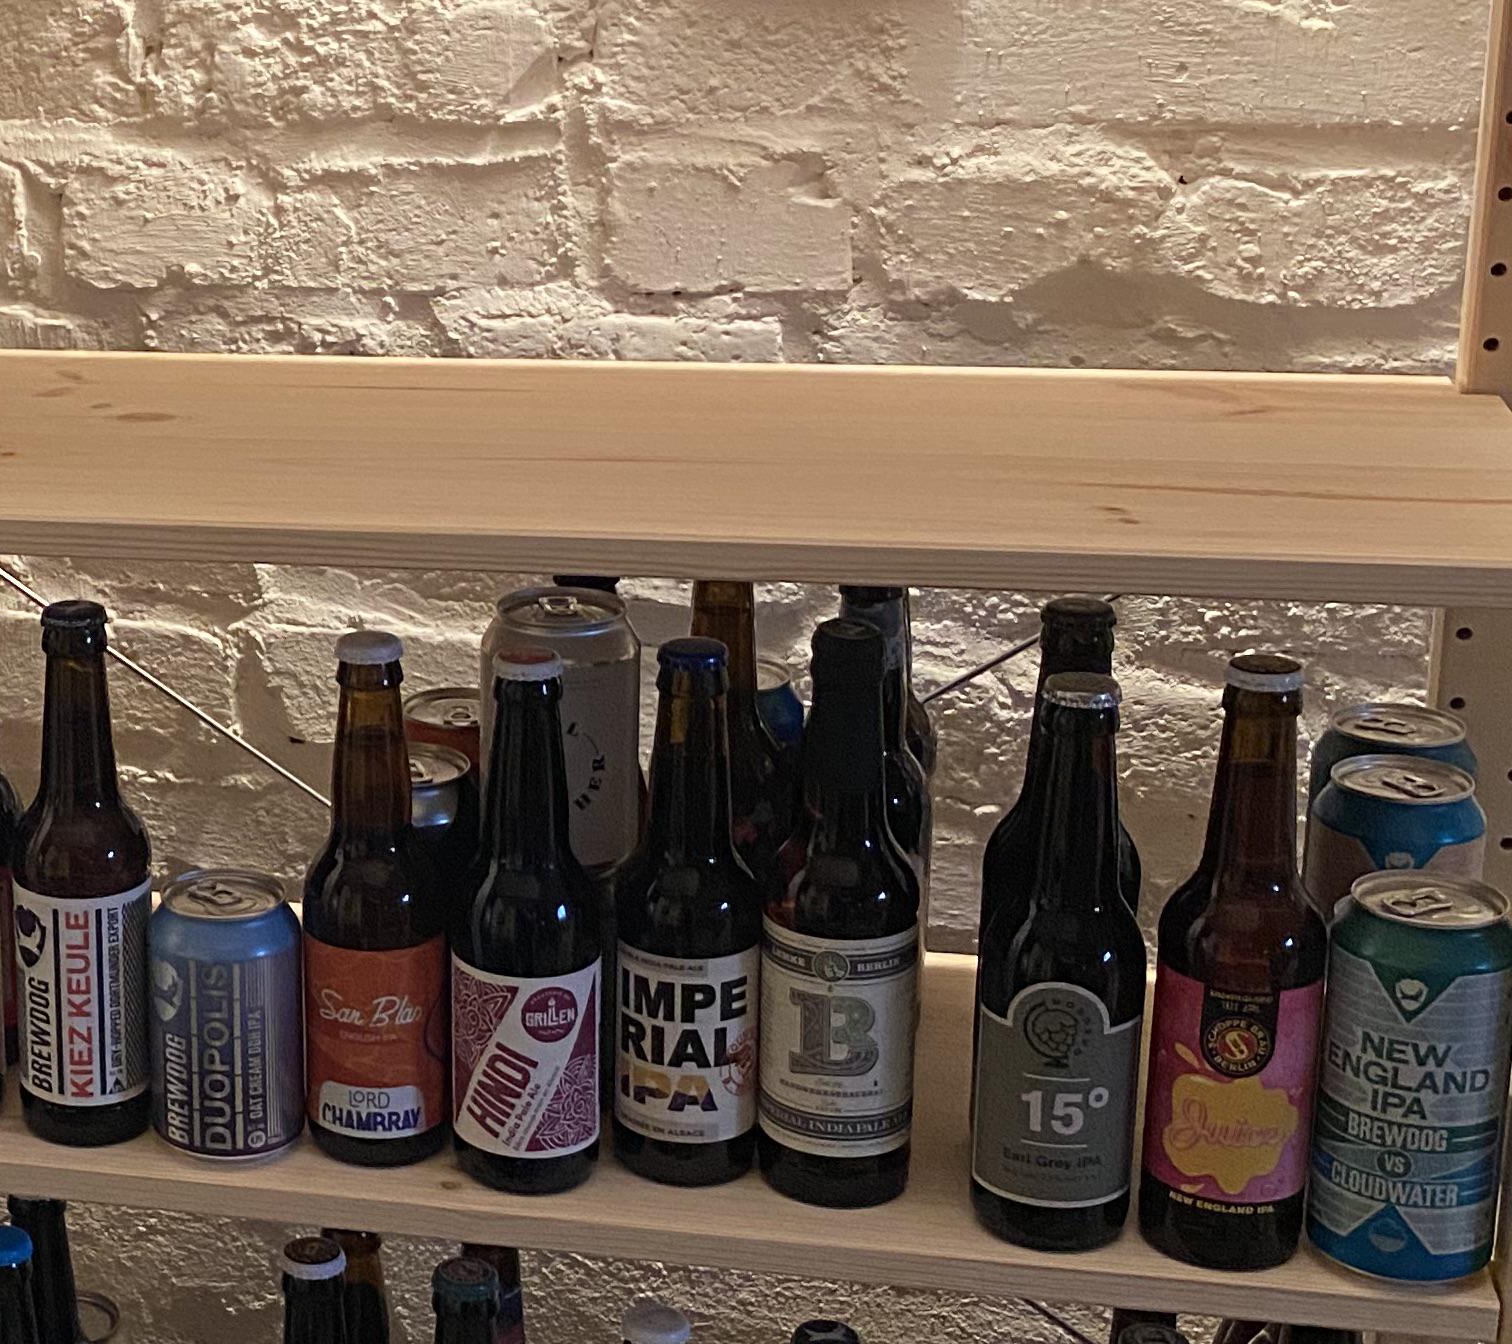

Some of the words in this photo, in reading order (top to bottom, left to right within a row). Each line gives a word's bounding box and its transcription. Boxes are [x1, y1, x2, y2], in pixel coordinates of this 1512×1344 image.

[64, 910, 92, 1018] KEULE
[856, 958, 900, 973] BERLIN
[319, 989, 367, 1027] San
[621, 965, 748, 1023] IMPE
[27, 976, 53, 1093] BREWDOG
[247, 1009, 262, 1033] IPA
[621, 1011, 740, 1069] RIAL
[788, 987, 880, 1076] B
[68, 1026, 94, 1098] KIEZ
[200, 963, 233, 1150] DUOPOLIS
[1213, 1052, 1257, 1073] BERLIN
[1328, 1039, 1491, 1095] ENGLAND
[1360, 1030, 1453, 1069] NEW
[164, 1033, 190, 1145] BREWDOG
[247, 1057, 263, 1095] CREAM
[468, 1041, 540, 1138] HINDI
[620, 1064, 719, 1112] IPA
[248, 1097, 264, 1119] OAT
[322, 1102, 421, 1132] CHAMBRAY
[349, 1089, 391, 1109] LORD
[1370, 1087, 1428, 1121] IPA
[808, 1117, 852, 1134] INDIA
[854, 1117, 889, 1133] PALE
[1348, 1114, 1449, 1153] BREWDOG
[1035, 1155, 1073, 1170] Grey
[1384, 1154, 1406, 1174] VS
[1168, 1189, 1192, 1205] NEW
[1195, 1200, 1254, 1215] ENGLAND
[1256, 1205, 1274, 1214] IPA
[1330, 1160, 1460, 1207] CLOUDWATER
